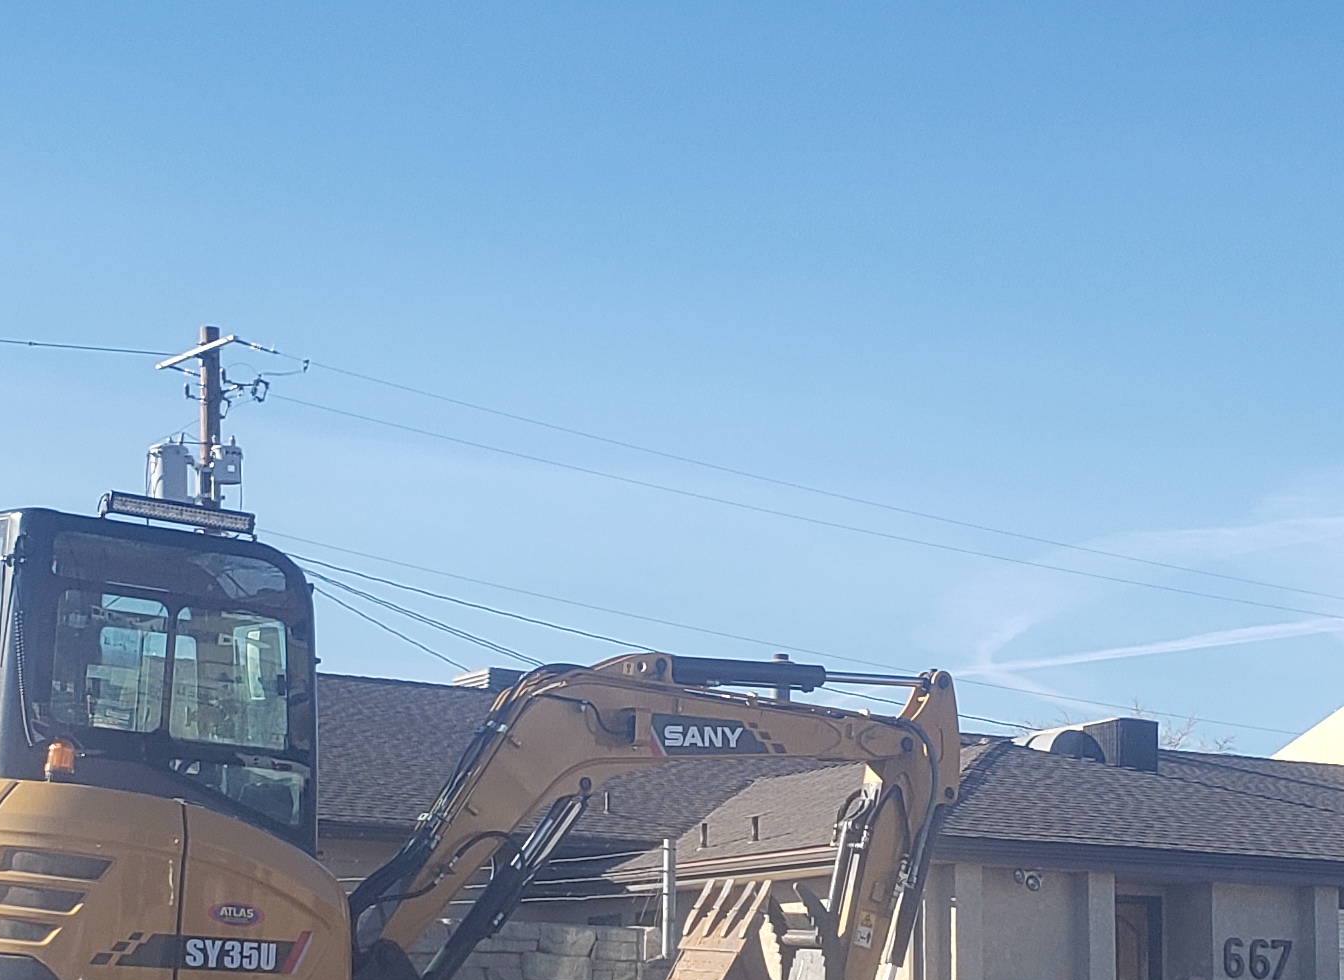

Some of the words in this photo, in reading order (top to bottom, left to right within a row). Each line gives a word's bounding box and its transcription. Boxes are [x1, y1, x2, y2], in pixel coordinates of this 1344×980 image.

[664, 725, 744, 748] SANY
[220, 906, 254, 918] ATLAS
[185, 938, 277, 971] SY35U
[1223, 937, 1293, 980] 667
